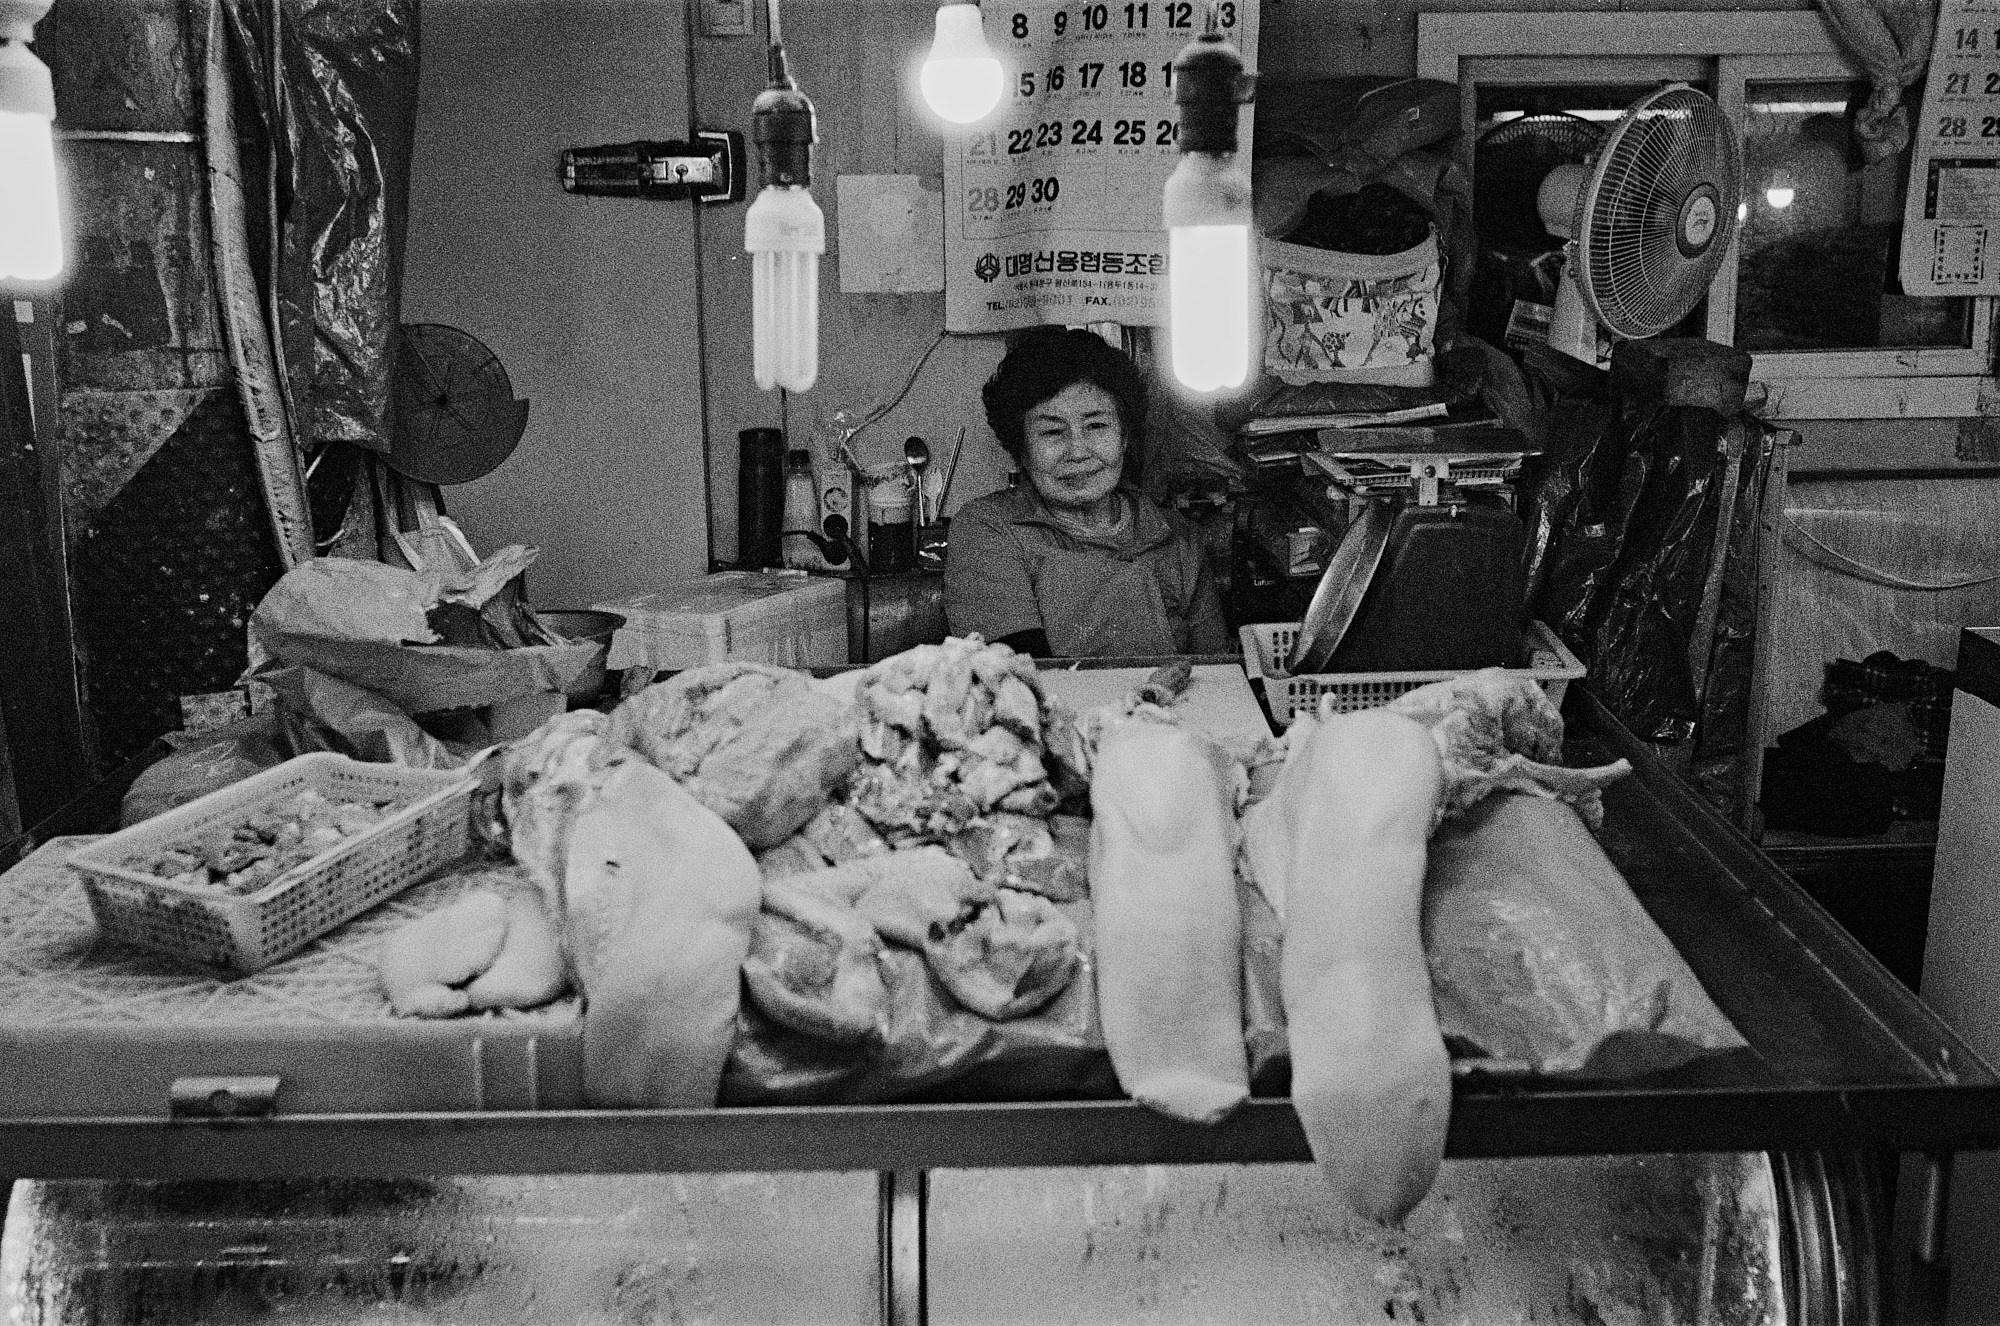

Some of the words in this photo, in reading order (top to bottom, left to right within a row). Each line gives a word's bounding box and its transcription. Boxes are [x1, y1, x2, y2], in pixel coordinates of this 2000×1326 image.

[1012, 13, 1028, 39] 8
[1054, 11, 1067, 36] 9
[1082, 4, 1108, 30] 10
[1124, 2, 1149, 28] 11
[1165, 2, 1193, 28] 12
[1220, 2, 1236, 28] 3
[1956, 28, 1979, 50] 14
[1046, 65, 1065, 93] 16
[1078, 62, 1104, 88] 17
[1119, 61, 1147, 88] 18
[1162, 61, 1172, 88] 1
[1946, 72, 1970, 94] 21
[1984, 72, 2000, 94] 2
[969, 131, 997, 156] 21
[1008, 128, 1033, 155] 22
[1036, 121, 1063, 148] 23
[1071, 119, 1103, 145] 24
[1114, 119, 1146, 146] 25
[1937, 116, 1967, 137] 28
[1981, 116, 2000, 137] 2
[968, 187, 999, 212] 28
[1005, 182, 1026, 210] 29
[1031, 177, 1060, 204] 30
